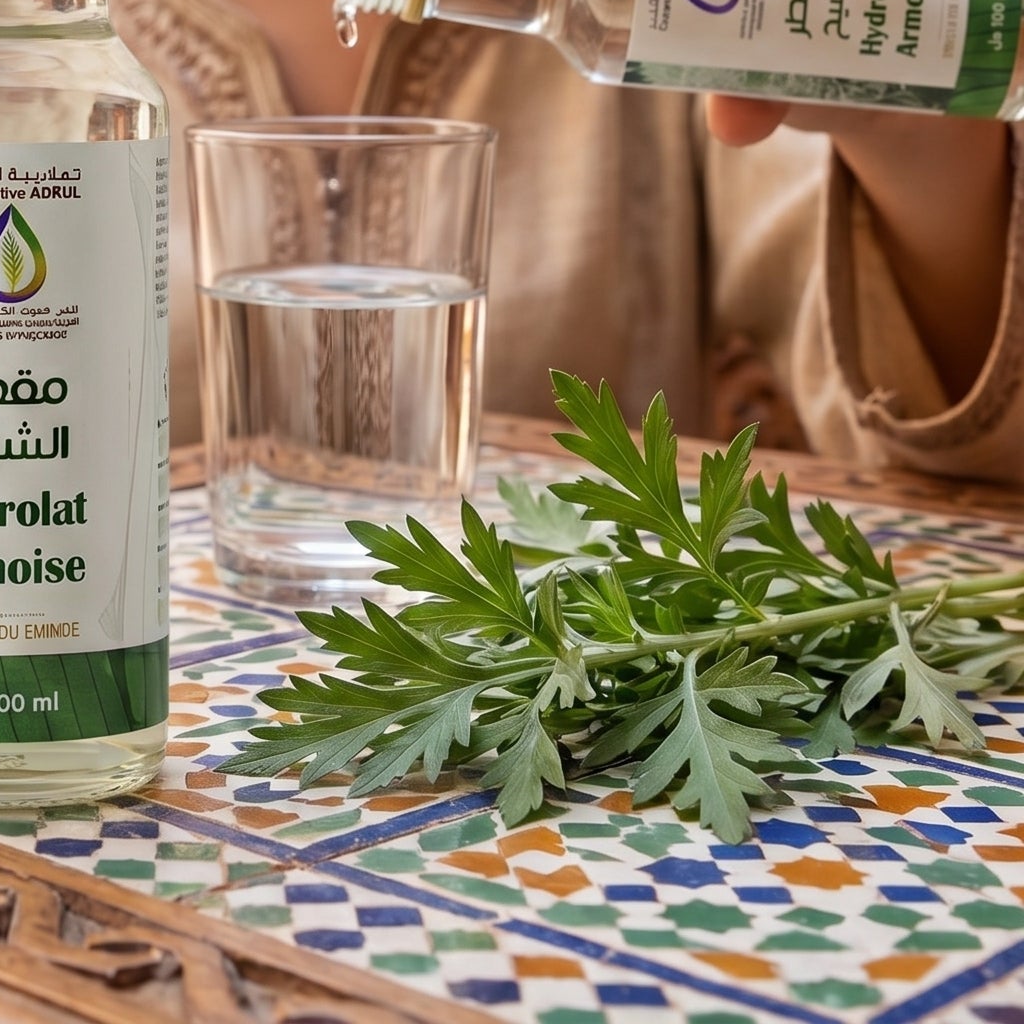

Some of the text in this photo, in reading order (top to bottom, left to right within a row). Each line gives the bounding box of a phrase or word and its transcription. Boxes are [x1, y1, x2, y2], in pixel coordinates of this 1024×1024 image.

[990, 2, 1006, 27] 100
[29, 185, 82, 199] ADRUL
[32, 690, 59, 712] ml
